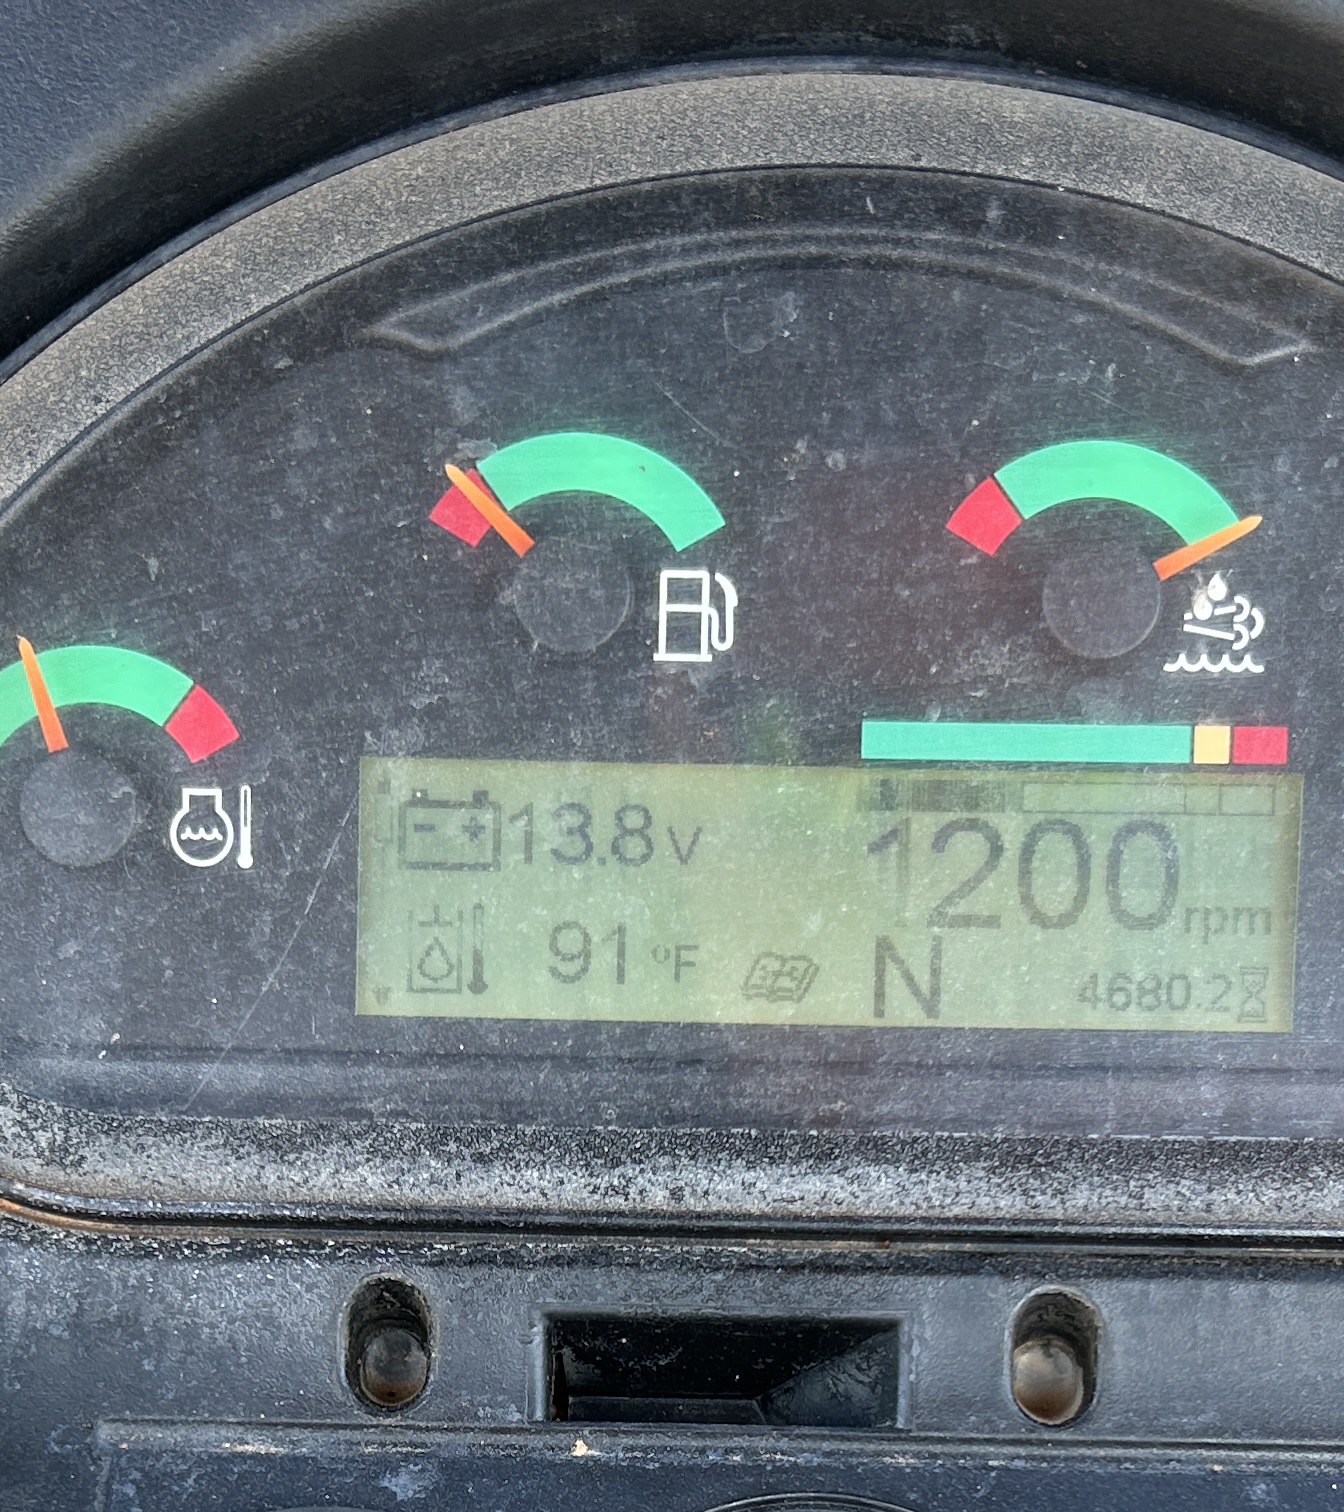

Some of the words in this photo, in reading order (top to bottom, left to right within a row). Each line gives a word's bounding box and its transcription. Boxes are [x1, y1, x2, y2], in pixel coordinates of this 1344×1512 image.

[508, 801, 654, 867] 13.8
[867, 817, 1180, 930] 1200
[1184, 906, 1272, 945] rpm
[548, 920, 627, 985] 91
[873, 934, 943, 1020] N
[1076, 971, 1233, 1013] 4680.2
